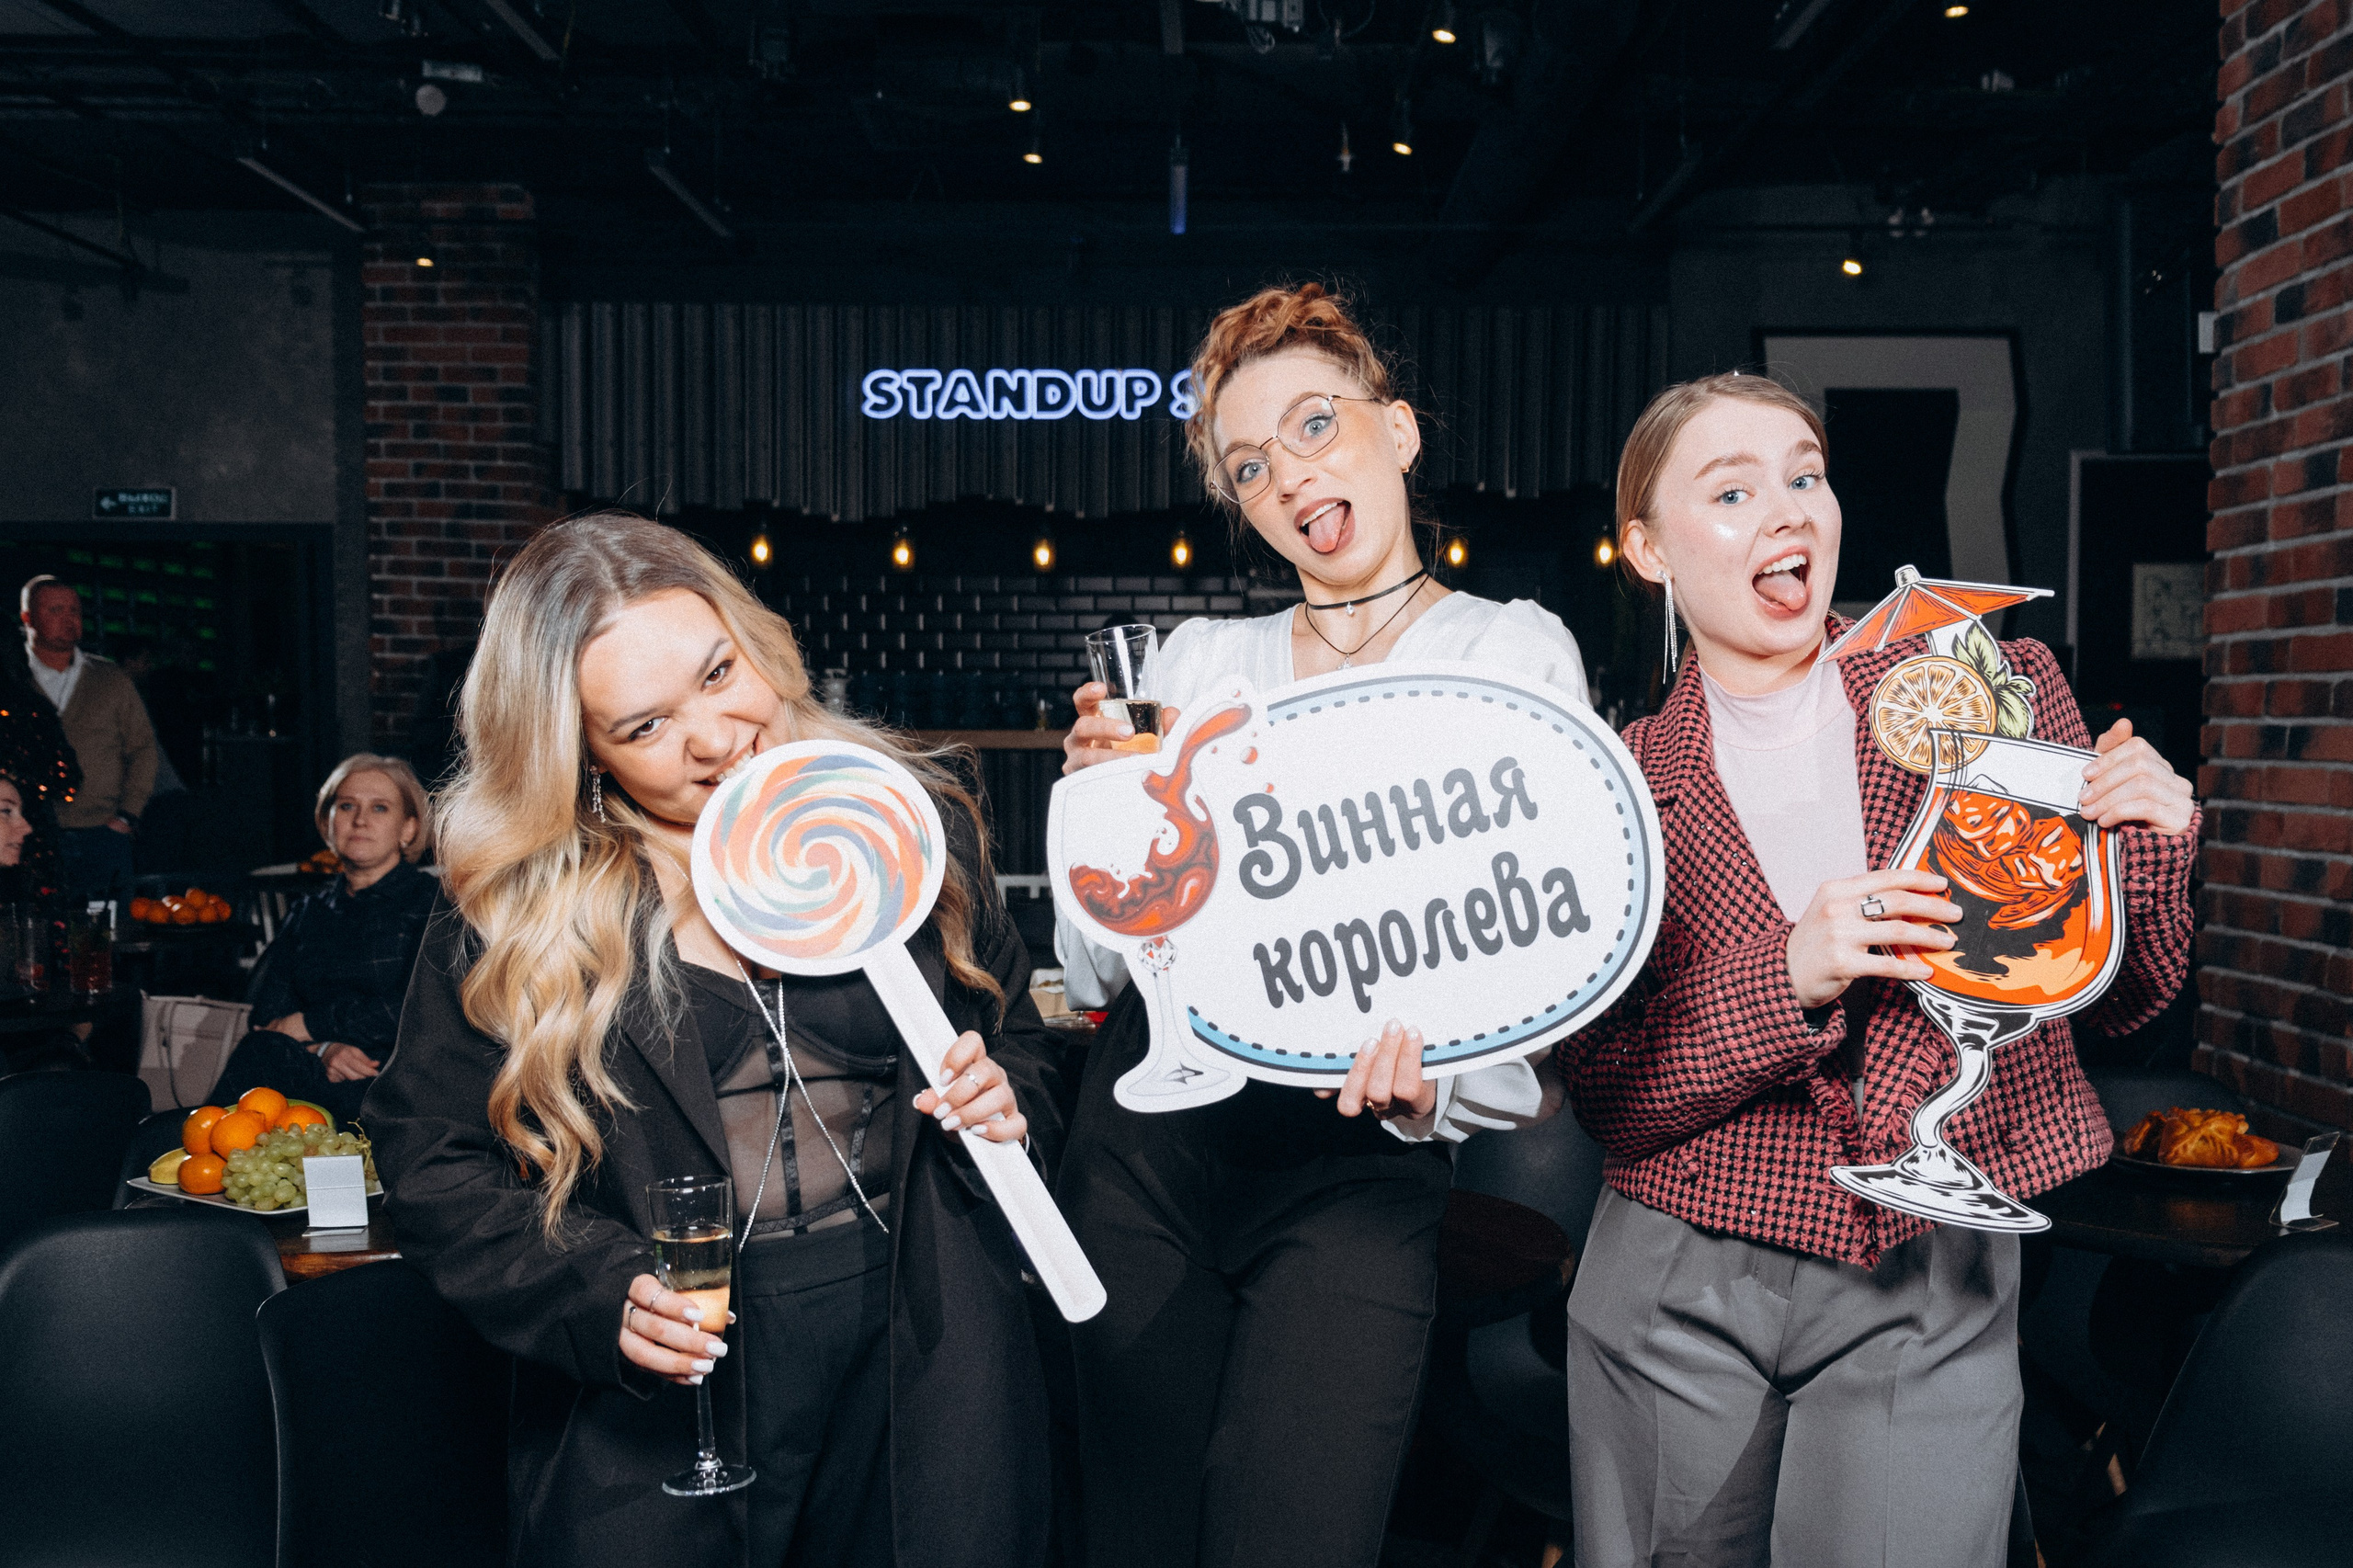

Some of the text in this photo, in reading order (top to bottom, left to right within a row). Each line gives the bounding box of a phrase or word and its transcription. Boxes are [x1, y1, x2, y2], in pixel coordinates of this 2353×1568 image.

[861, 369, 1204, 420] STANDUP S
[1233, 756, 1538, 900] Винная
[1253, 851, 1591, 1013] королева
